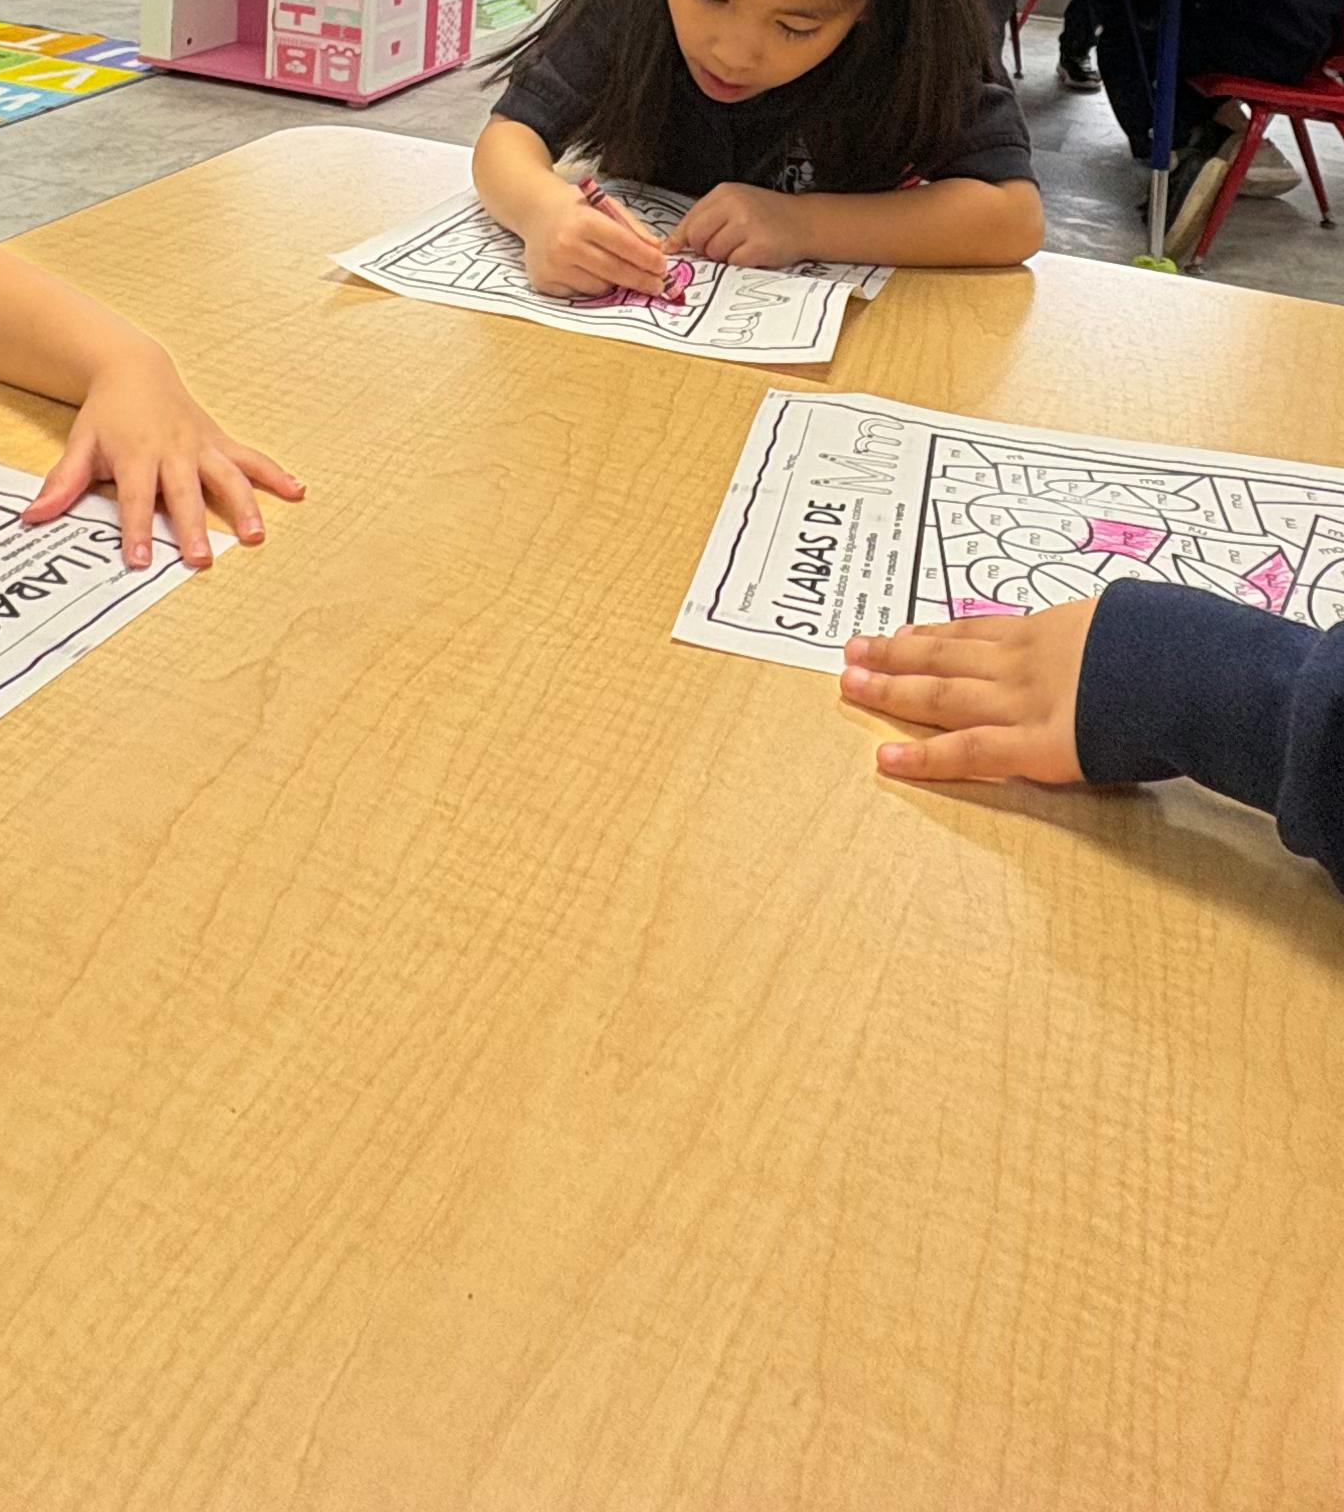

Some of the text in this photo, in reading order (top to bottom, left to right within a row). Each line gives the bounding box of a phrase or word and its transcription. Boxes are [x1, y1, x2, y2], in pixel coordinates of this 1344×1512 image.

[812, 416, 905, 497] Mm
[803, 500, 846, 525] DE
[923, 567, 937, 579] mi
